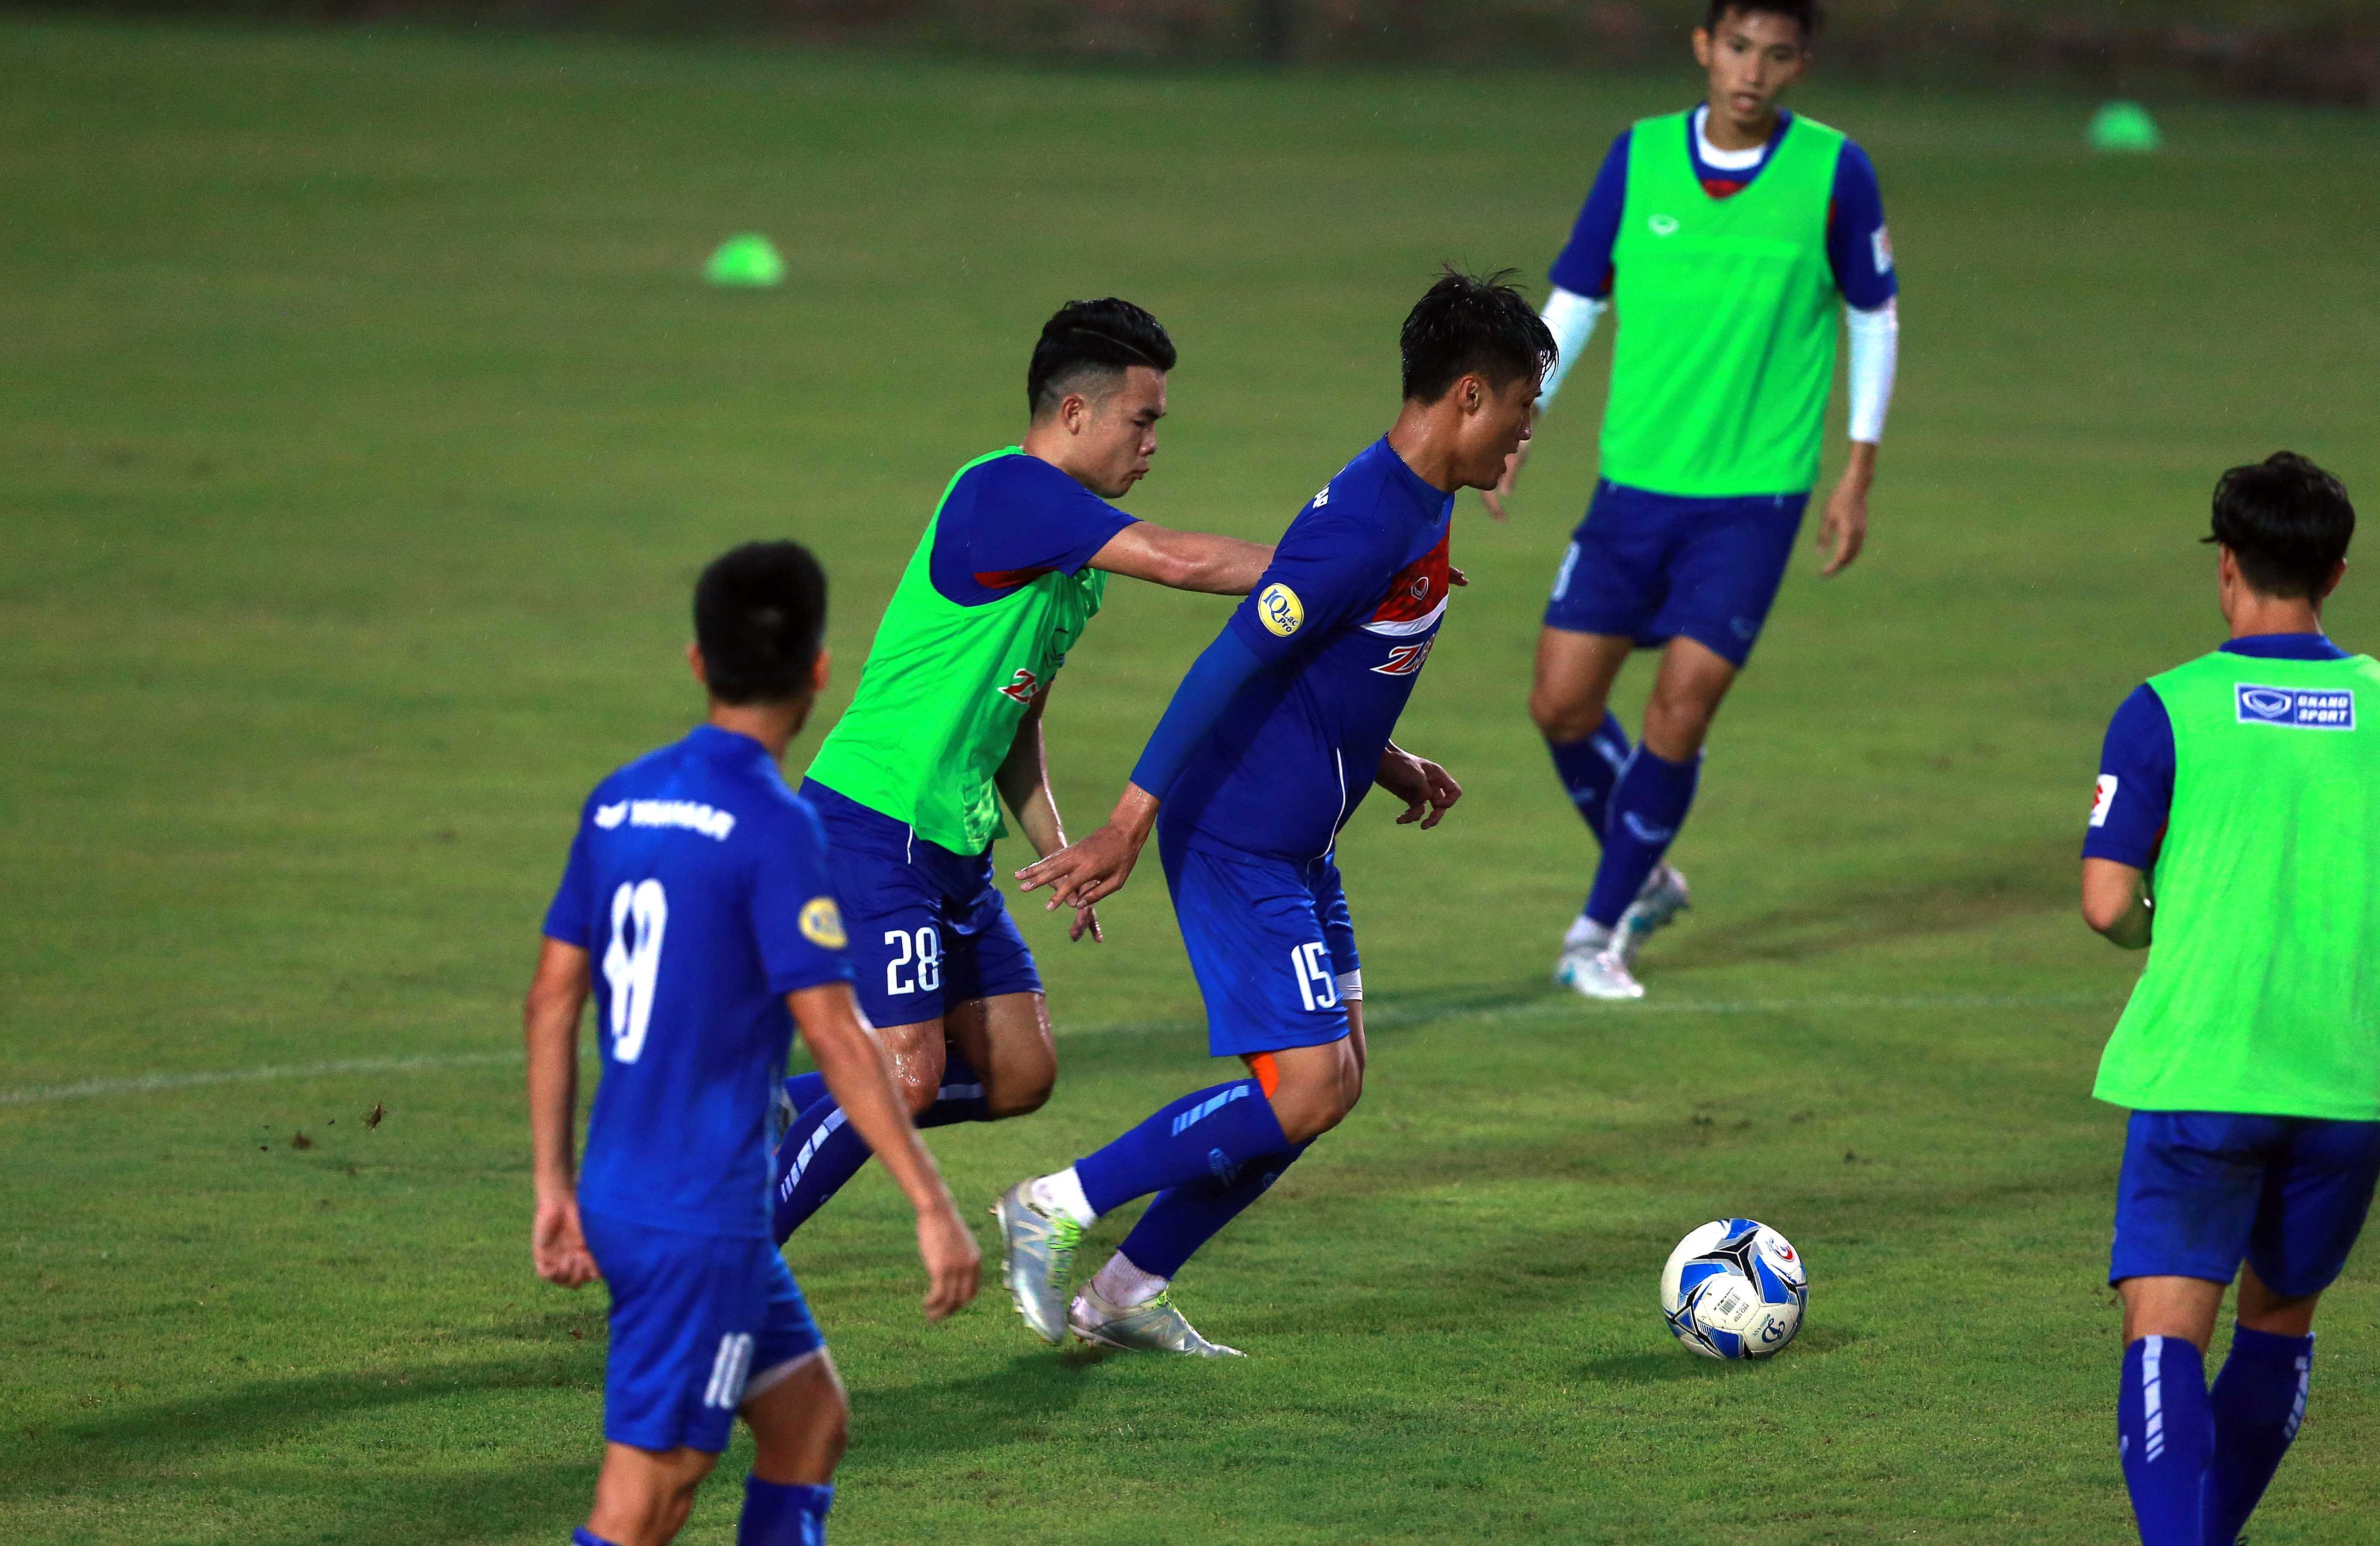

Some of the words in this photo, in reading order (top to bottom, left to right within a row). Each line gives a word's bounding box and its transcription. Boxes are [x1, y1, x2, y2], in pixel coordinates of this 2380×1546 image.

[1263, 588, 1288, 623] IQ
[1282, 607, 1299, 626] Lac
[1277, 617, 1293, 632] Pro
[884, 927, 939, 996] 28
[1291, 941, 1336, 1011] 15
